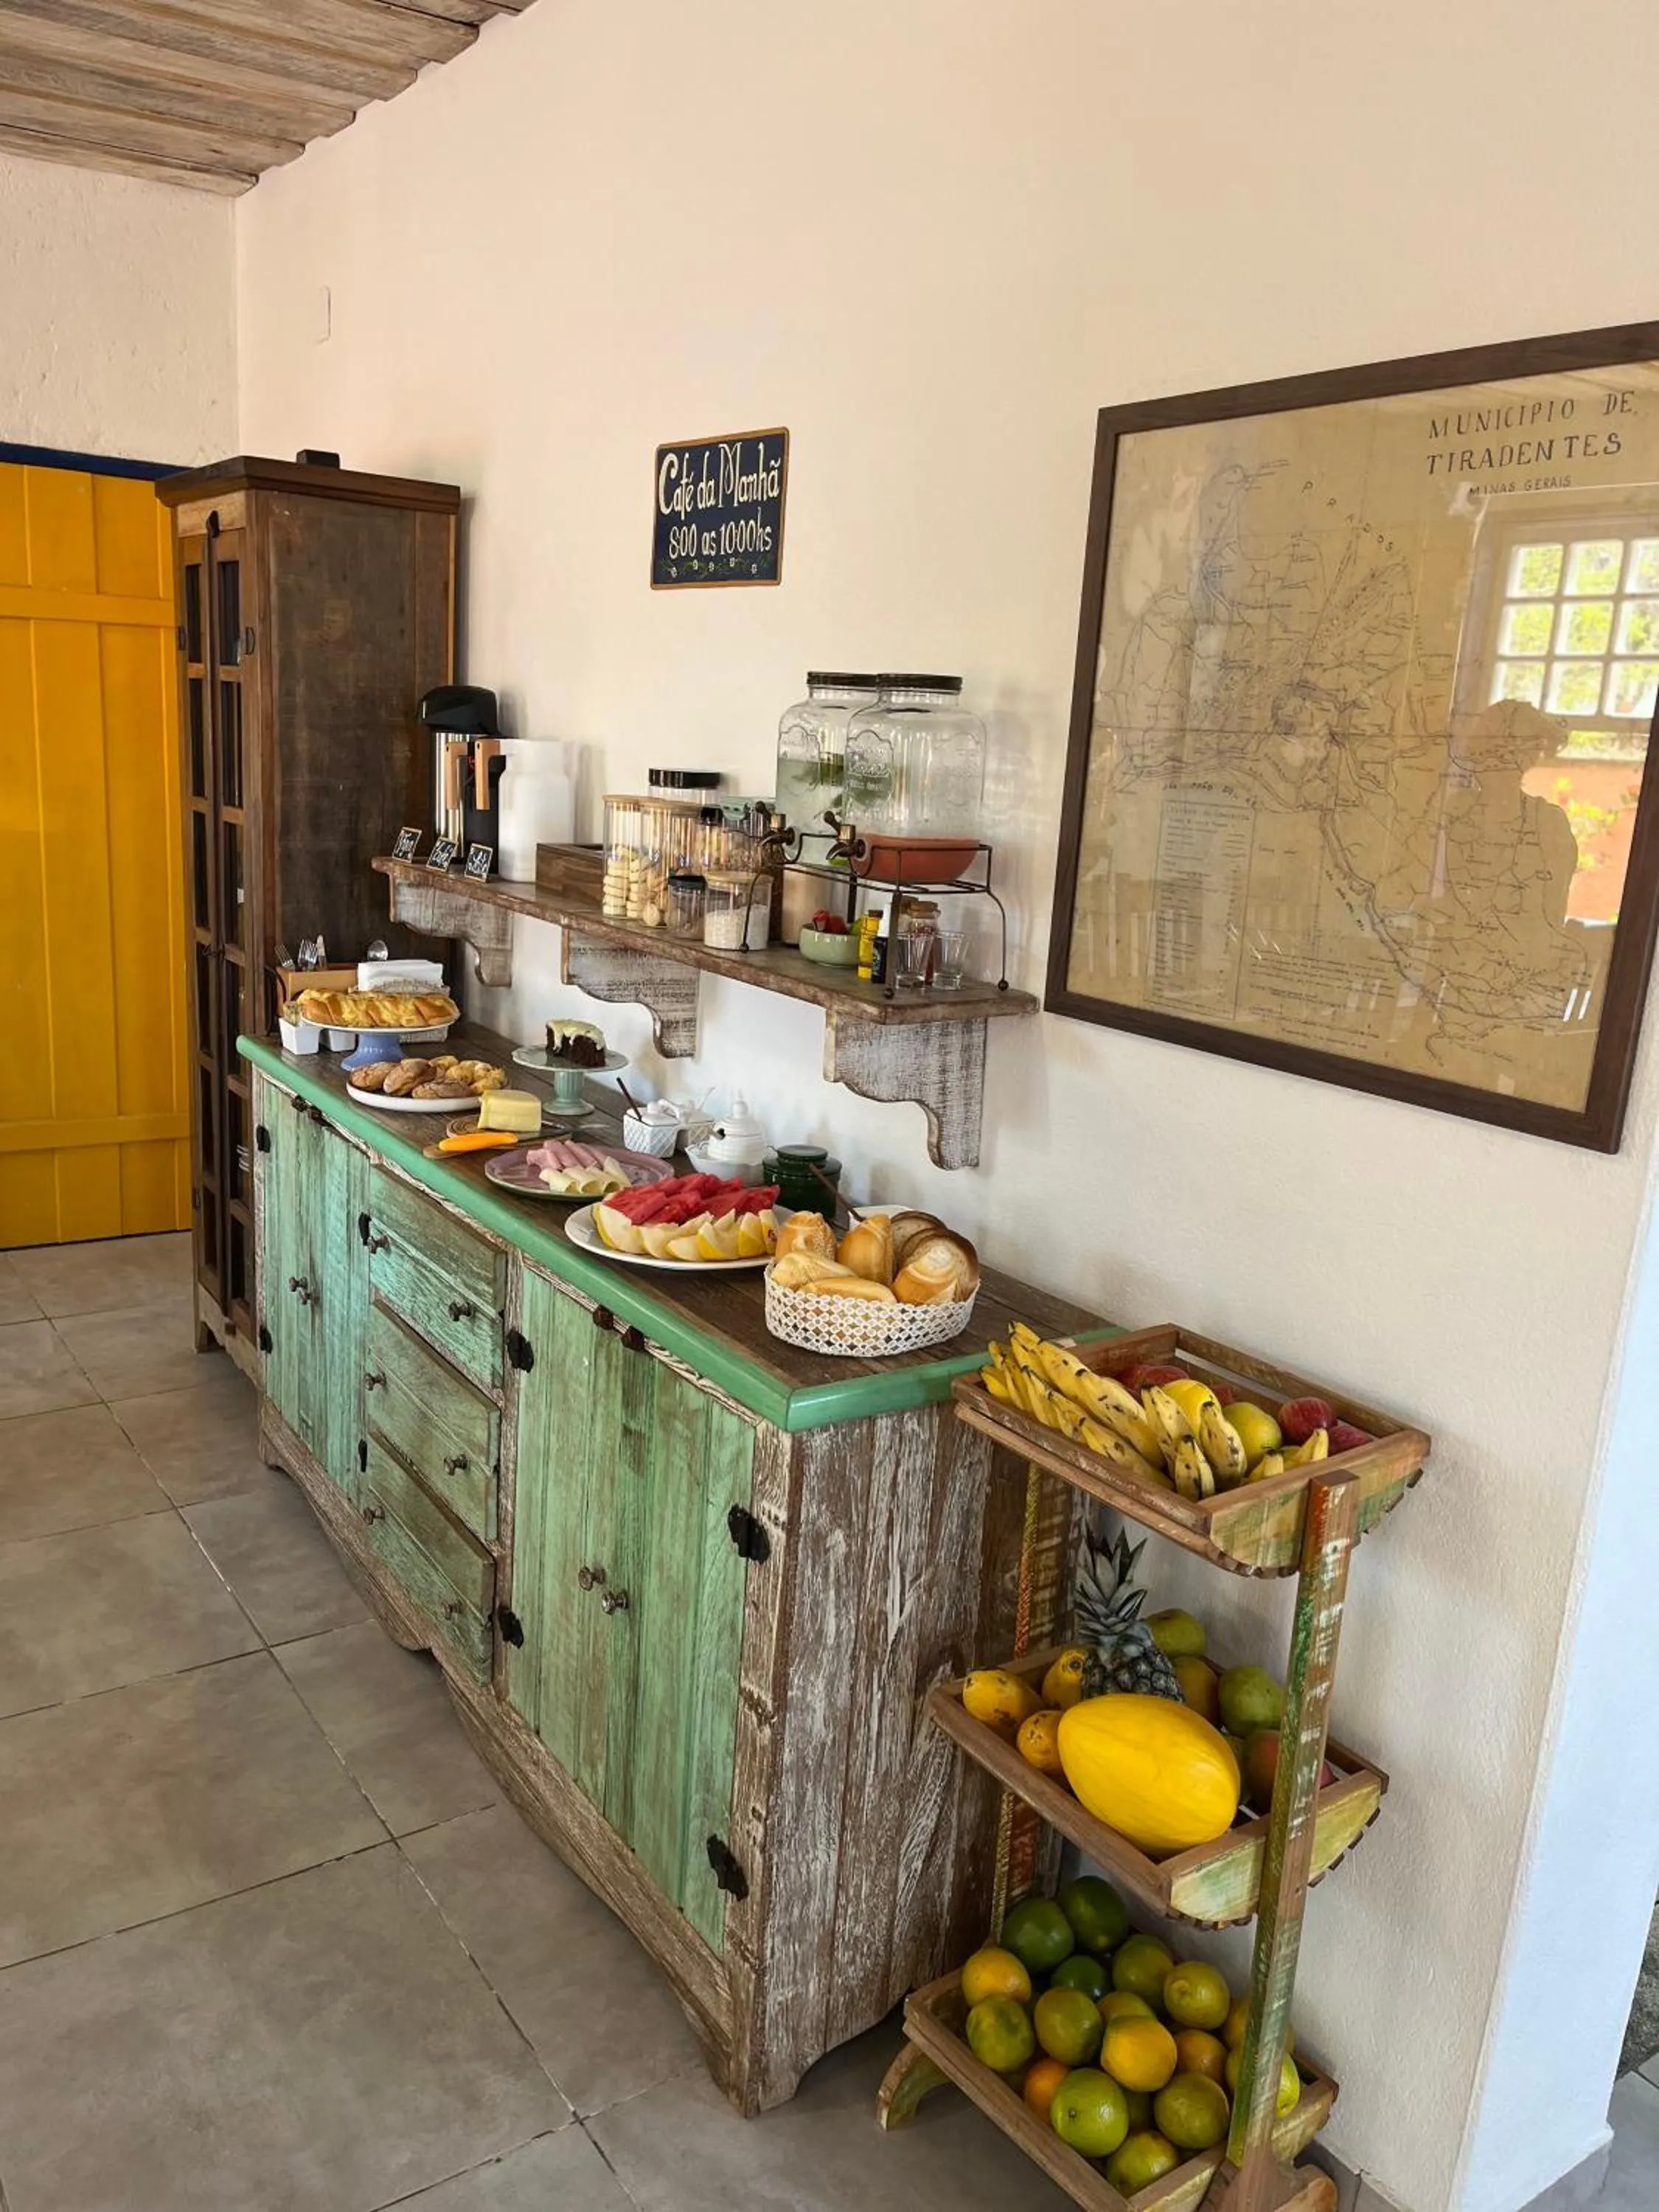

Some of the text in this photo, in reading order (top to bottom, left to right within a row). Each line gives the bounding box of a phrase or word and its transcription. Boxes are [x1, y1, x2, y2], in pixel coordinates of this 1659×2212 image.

[1428, 398, 1575, 439] MUNICIPIO
[1427, 432, 1623, 476] TIRADENTES
[658, 442, 781, 521] Café da Manhã
[1470, 475, 1572, 495] MINAS GERAIS
[701, 531, 717, 556] as
